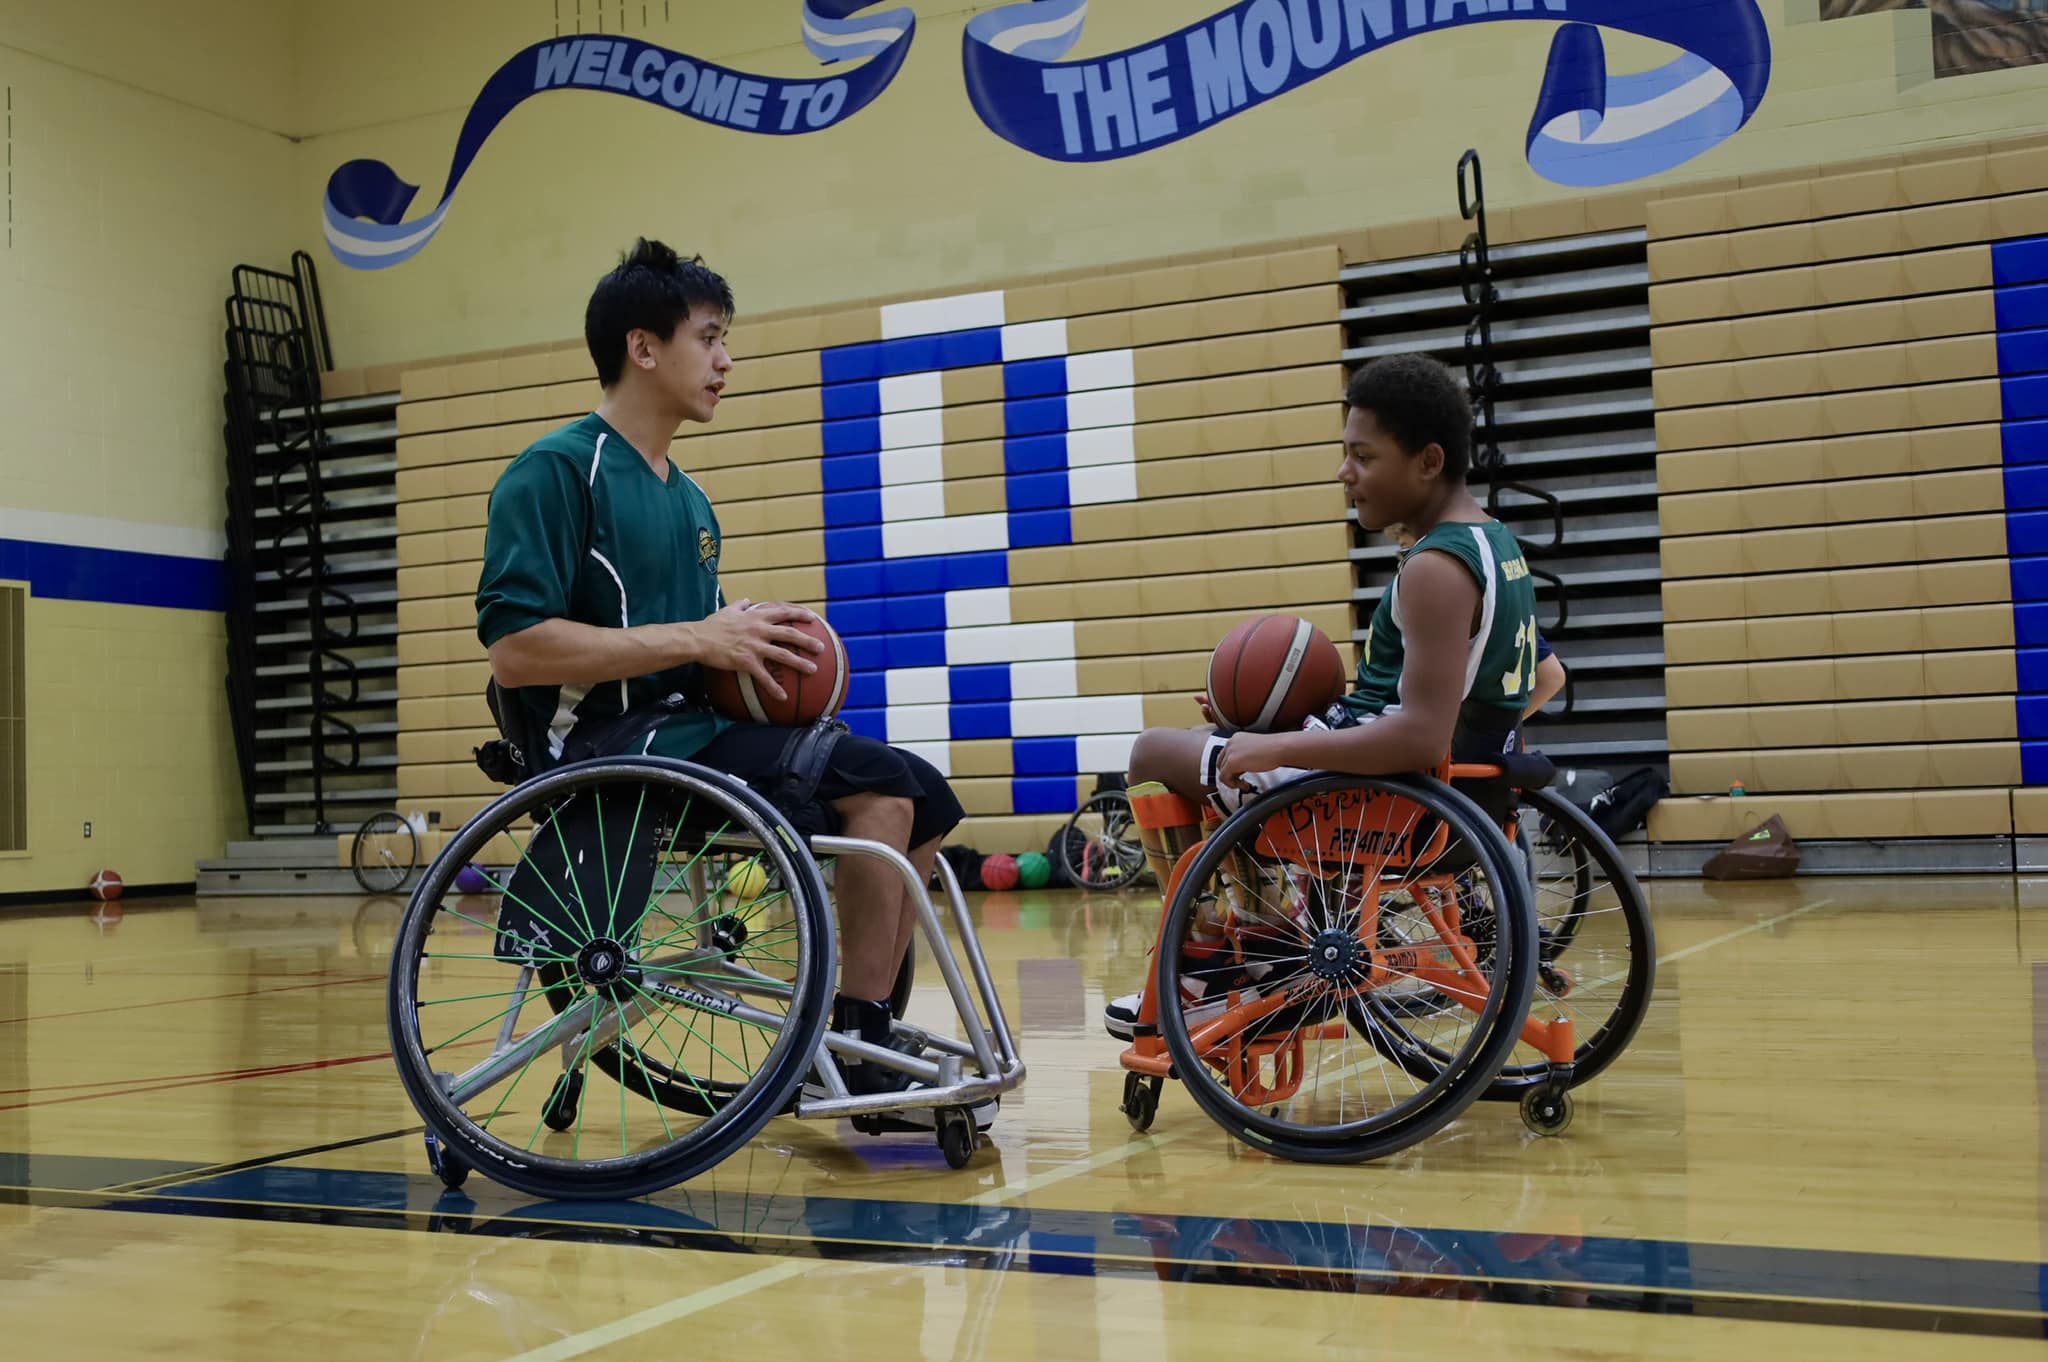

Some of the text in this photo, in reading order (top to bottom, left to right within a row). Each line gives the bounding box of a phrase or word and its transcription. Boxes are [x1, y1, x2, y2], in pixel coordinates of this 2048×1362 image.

[534, 40, 848, 130] WELCOME TO
[1041, 0, 1567, 155] THE MOUN
